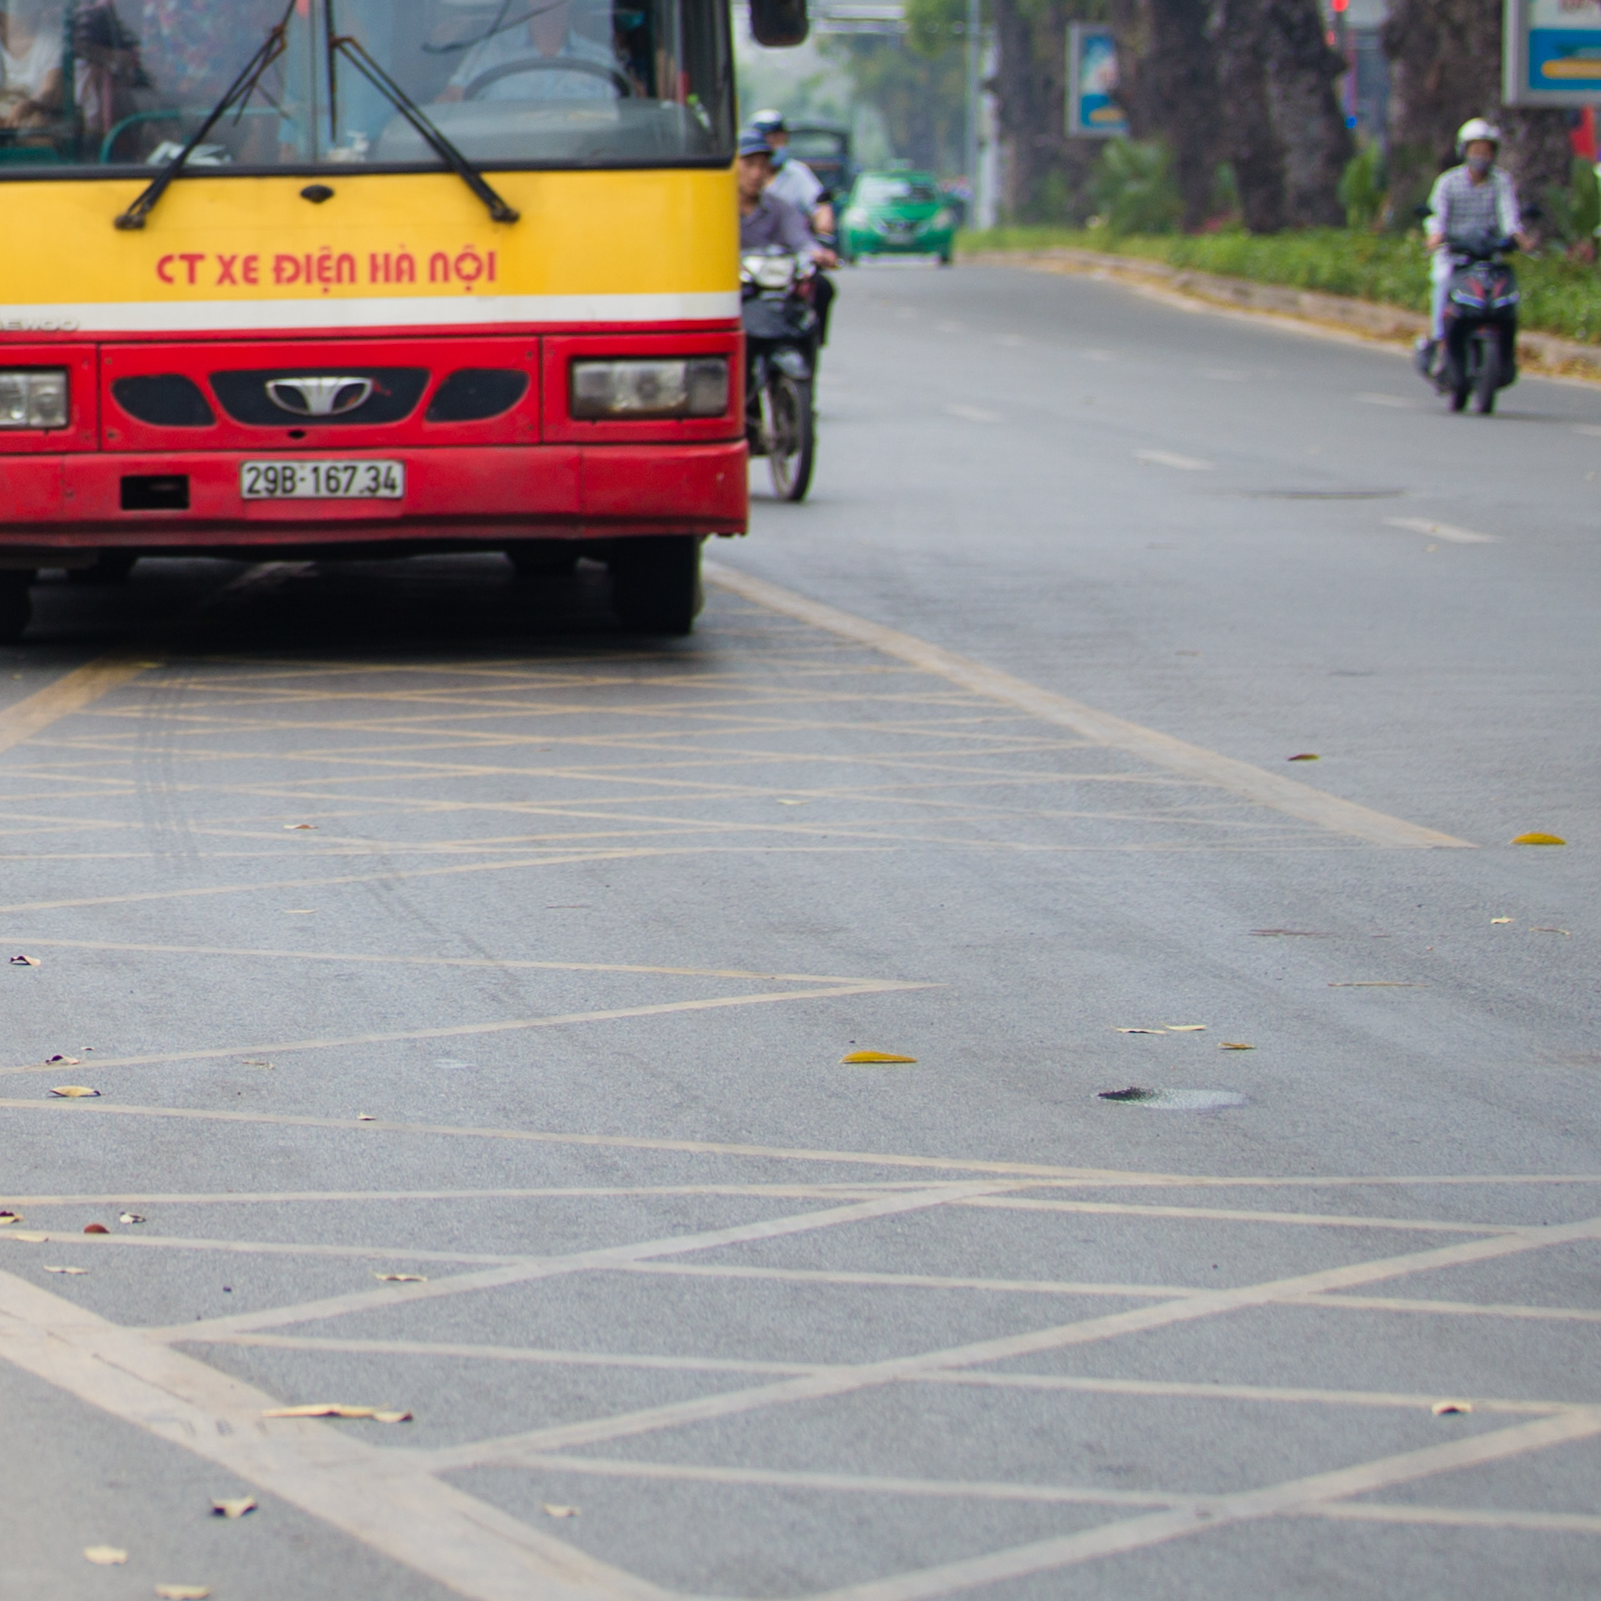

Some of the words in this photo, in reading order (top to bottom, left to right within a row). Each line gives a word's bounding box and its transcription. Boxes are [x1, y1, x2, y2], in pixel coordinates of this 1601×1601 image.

[156, 253, 206, 286] CT
[215, 253, 260, 287] XE
[369, 243, 416, 285] HÀ
